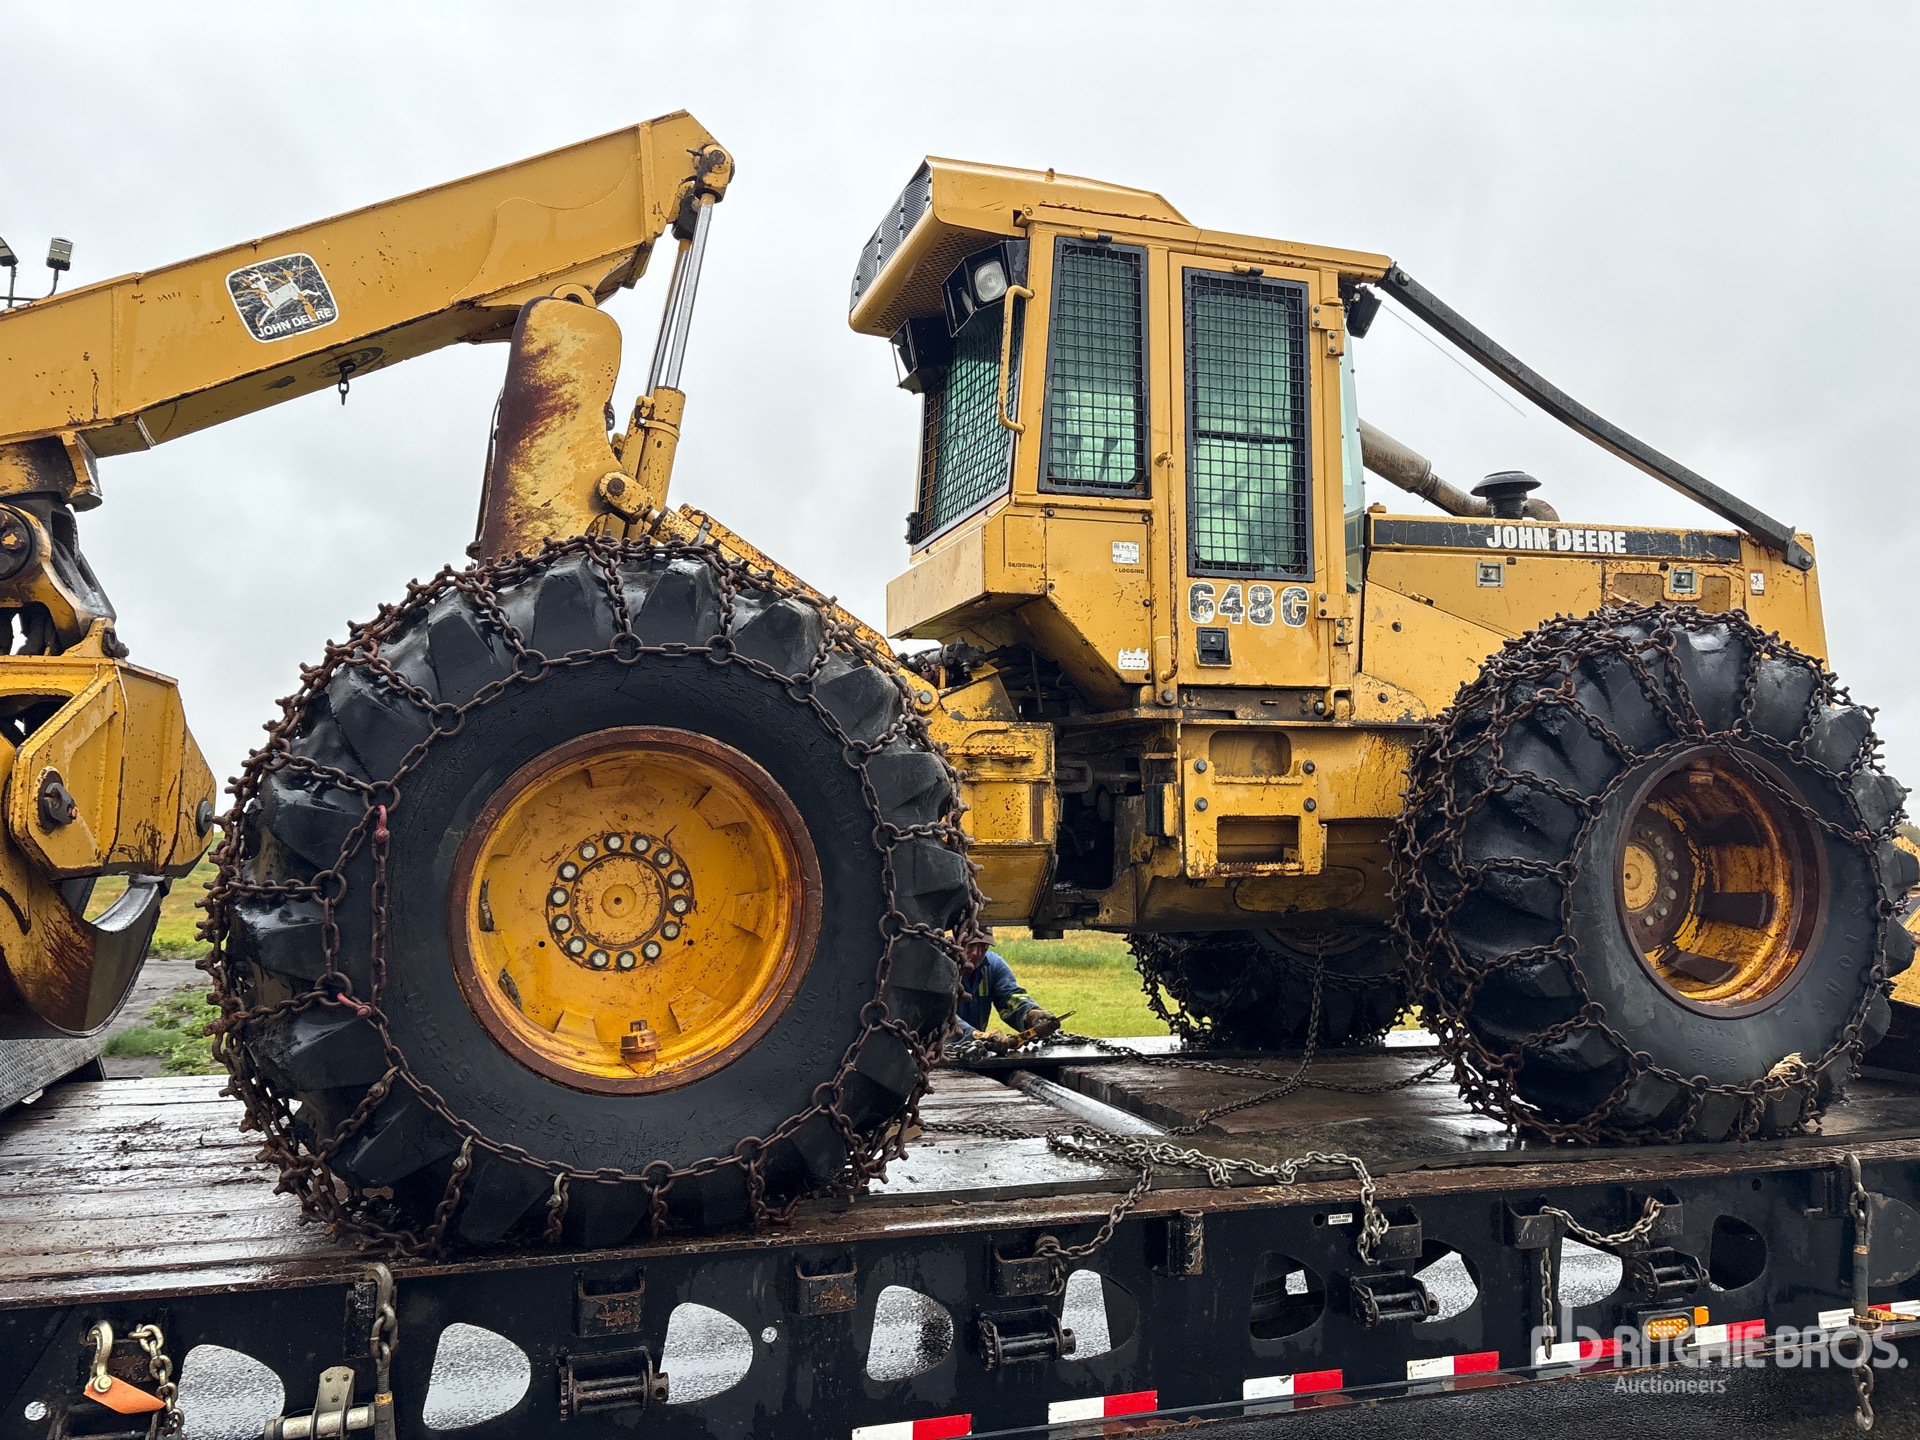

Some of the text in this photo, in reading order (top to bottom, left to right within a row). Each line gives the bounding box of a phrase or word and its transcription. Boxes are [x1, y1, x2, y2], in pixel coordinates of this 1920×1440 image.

[258, 319, 291, 338] JOHN
[1486, 525, 1627, 553] JOHN DEERE
[1188, 582, 1310, 628] 648G
